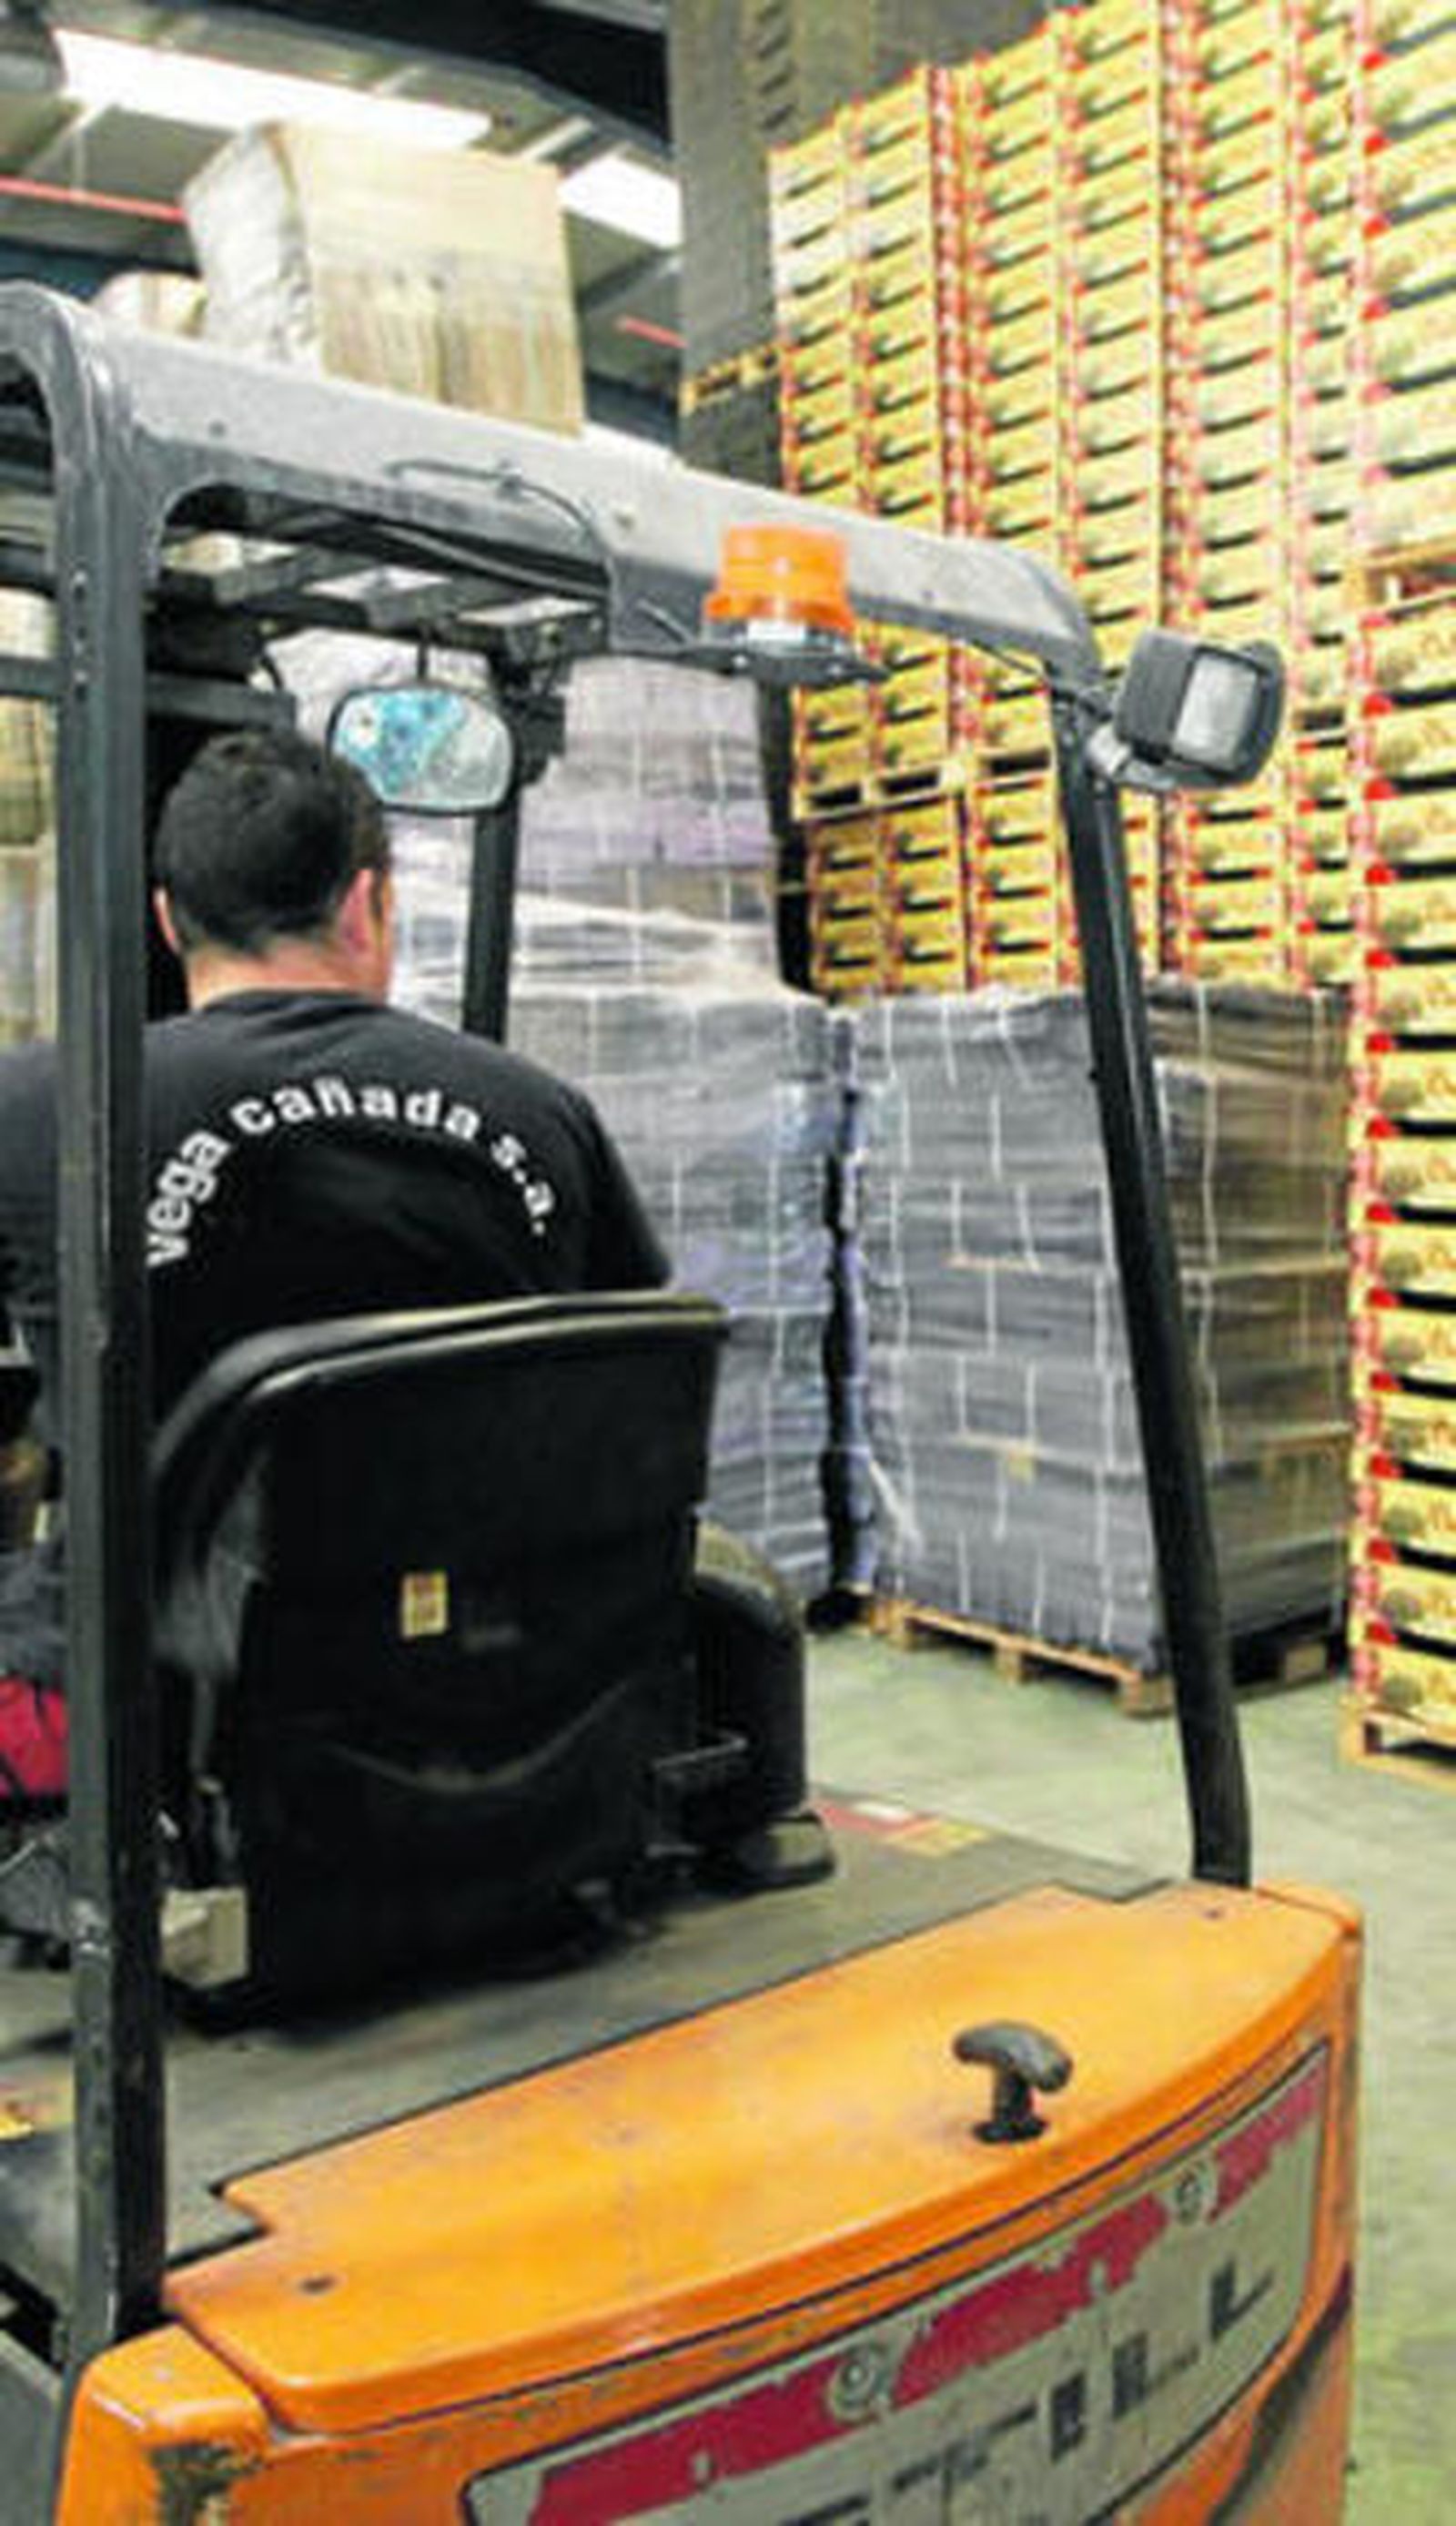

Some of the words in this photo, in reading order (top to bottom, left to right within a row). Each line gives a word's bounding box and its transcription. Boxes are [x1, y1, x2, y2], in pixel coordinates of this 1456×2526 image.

[147, 1131, 231, 1268] vega
[229, 1076, 480, 1141] cañada
[490, 1134, 555, 1236] s.a.
